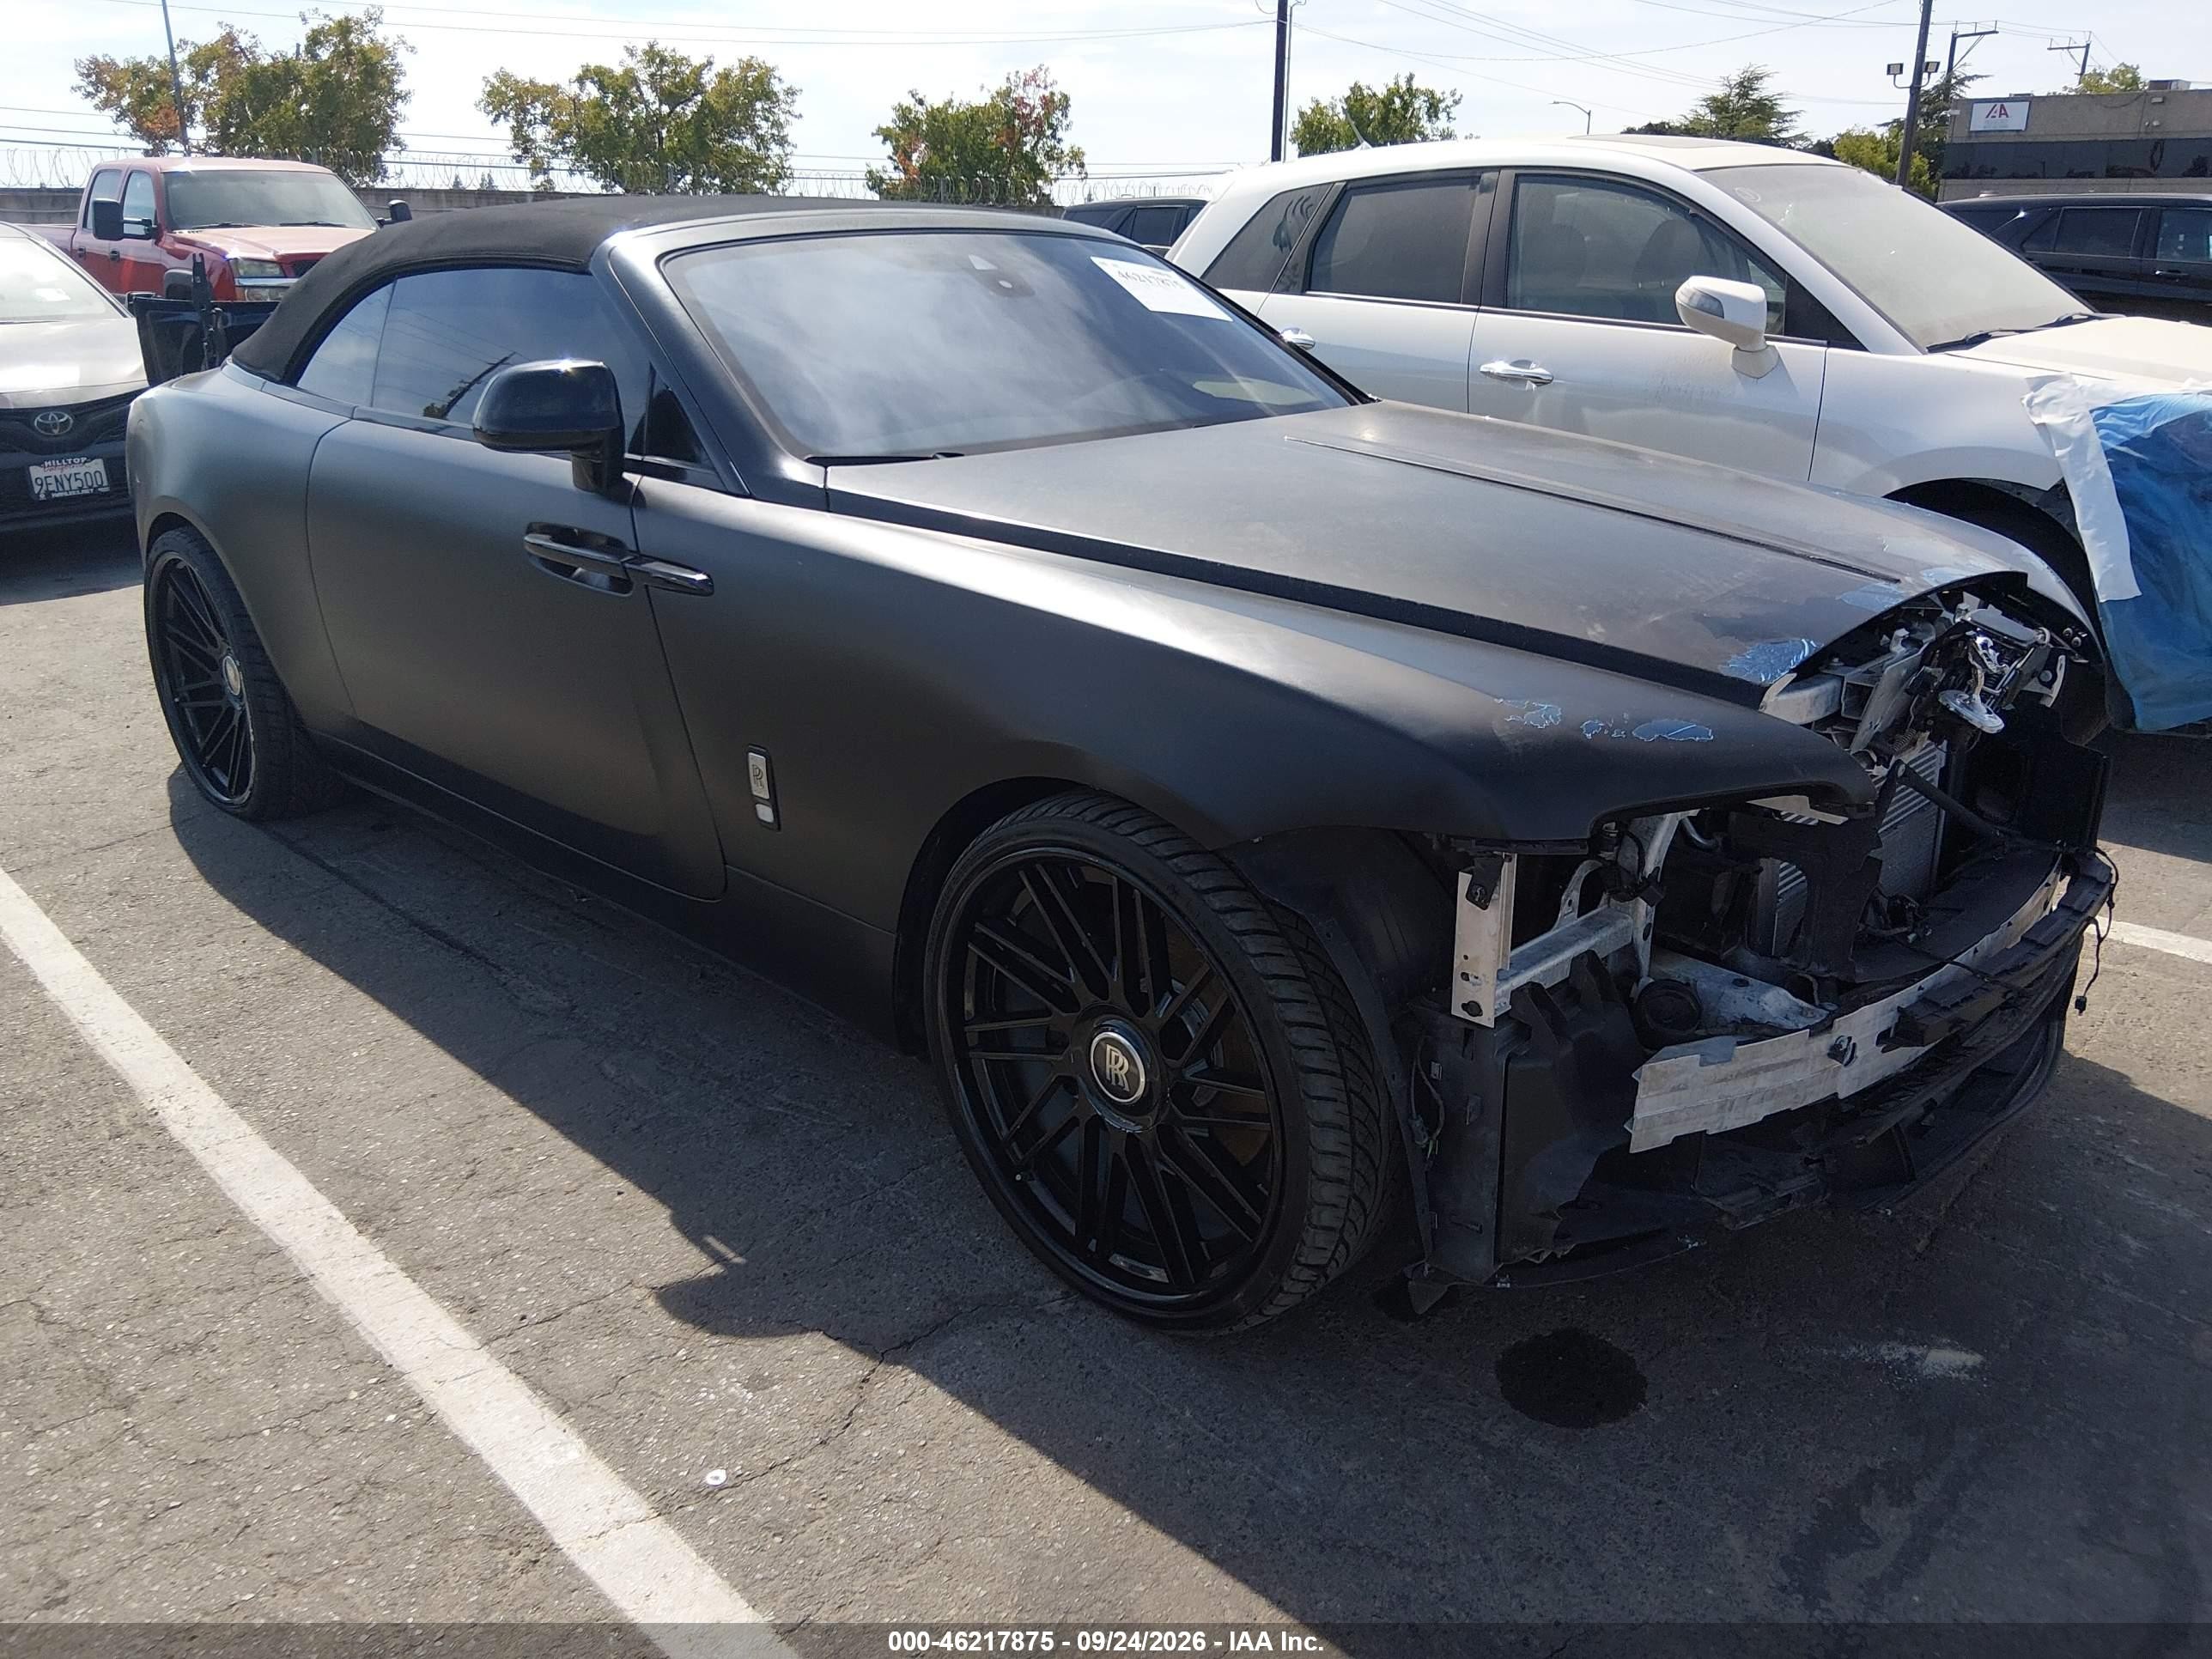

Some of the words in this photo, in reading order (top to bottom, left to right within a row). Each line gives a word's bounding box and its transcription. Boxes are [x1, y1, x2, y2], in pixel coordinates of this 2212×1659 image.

[44, 457, 88, 468] HILLTOP
[34, 471, 103, 495] 9ENY500
[1105, 1043, 1130, 1092] RR
